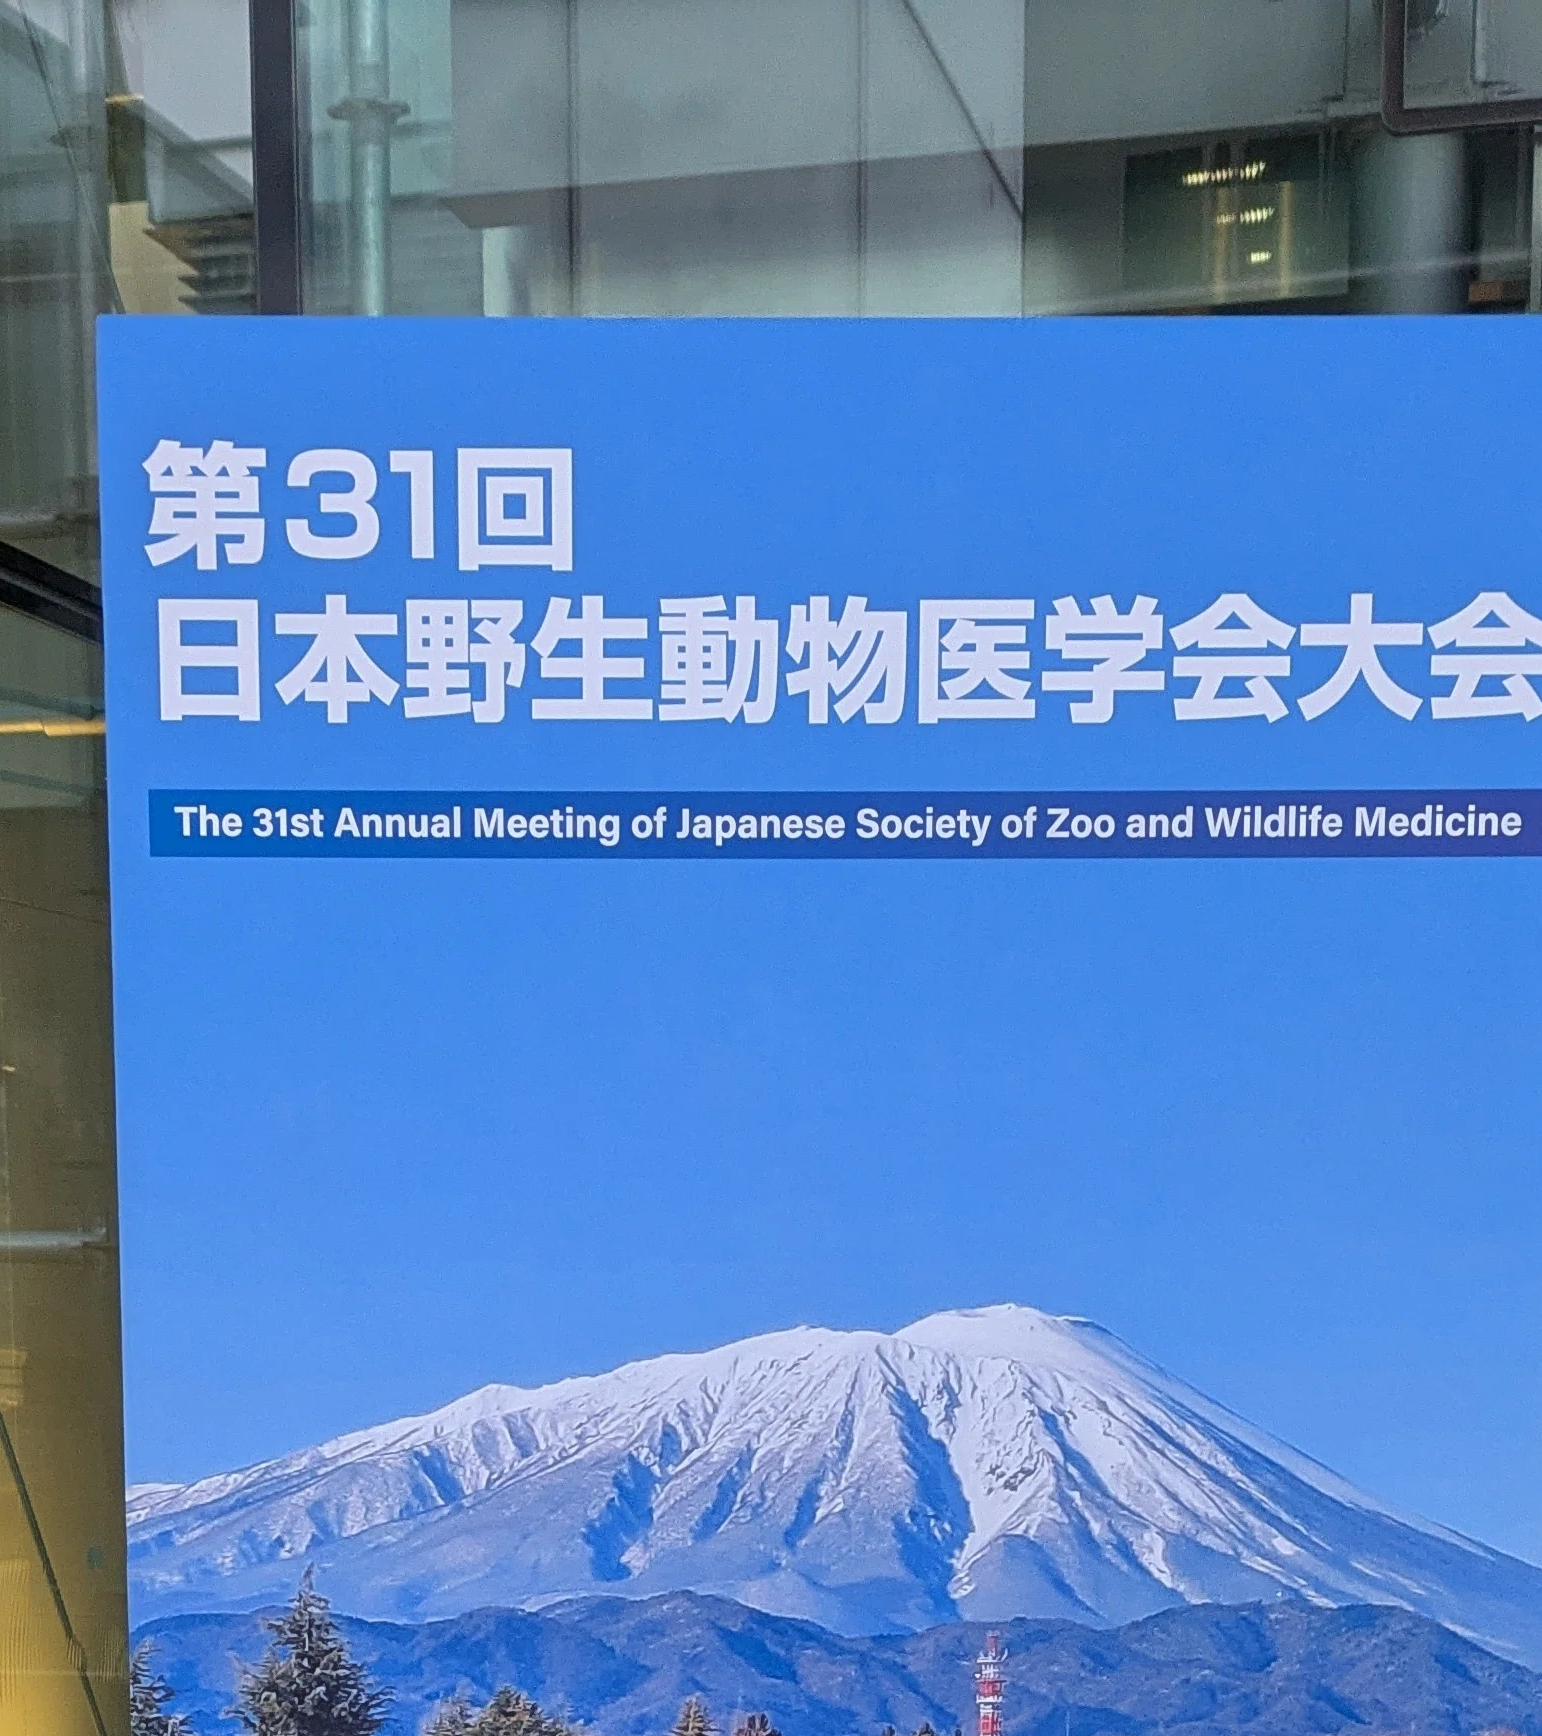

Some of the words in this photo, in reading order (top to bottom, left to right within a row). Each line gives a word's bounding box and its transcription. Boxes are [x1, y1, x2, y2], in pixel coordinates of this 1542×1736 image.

[142, 439, 573, 571] 第31回
[174, 805, 242, 838] The
[252, 807, 325, 838] 31st
[333, 805, 461, 838] Annual
[474, 806, 620, 846] Meeting
[631, 806, 667, 839] of
[676, 808, 846, 847] Japanese
[855, 807, 992, 846] Society
[1001, 806, 1038, 839] of
[1047, 808, 1116, 839] Zoo
[1125, 806, 1194, 839] and
[1204, 805, 1343, 838] Wildlife
[1354, 805, 1522, 837] Medicine
